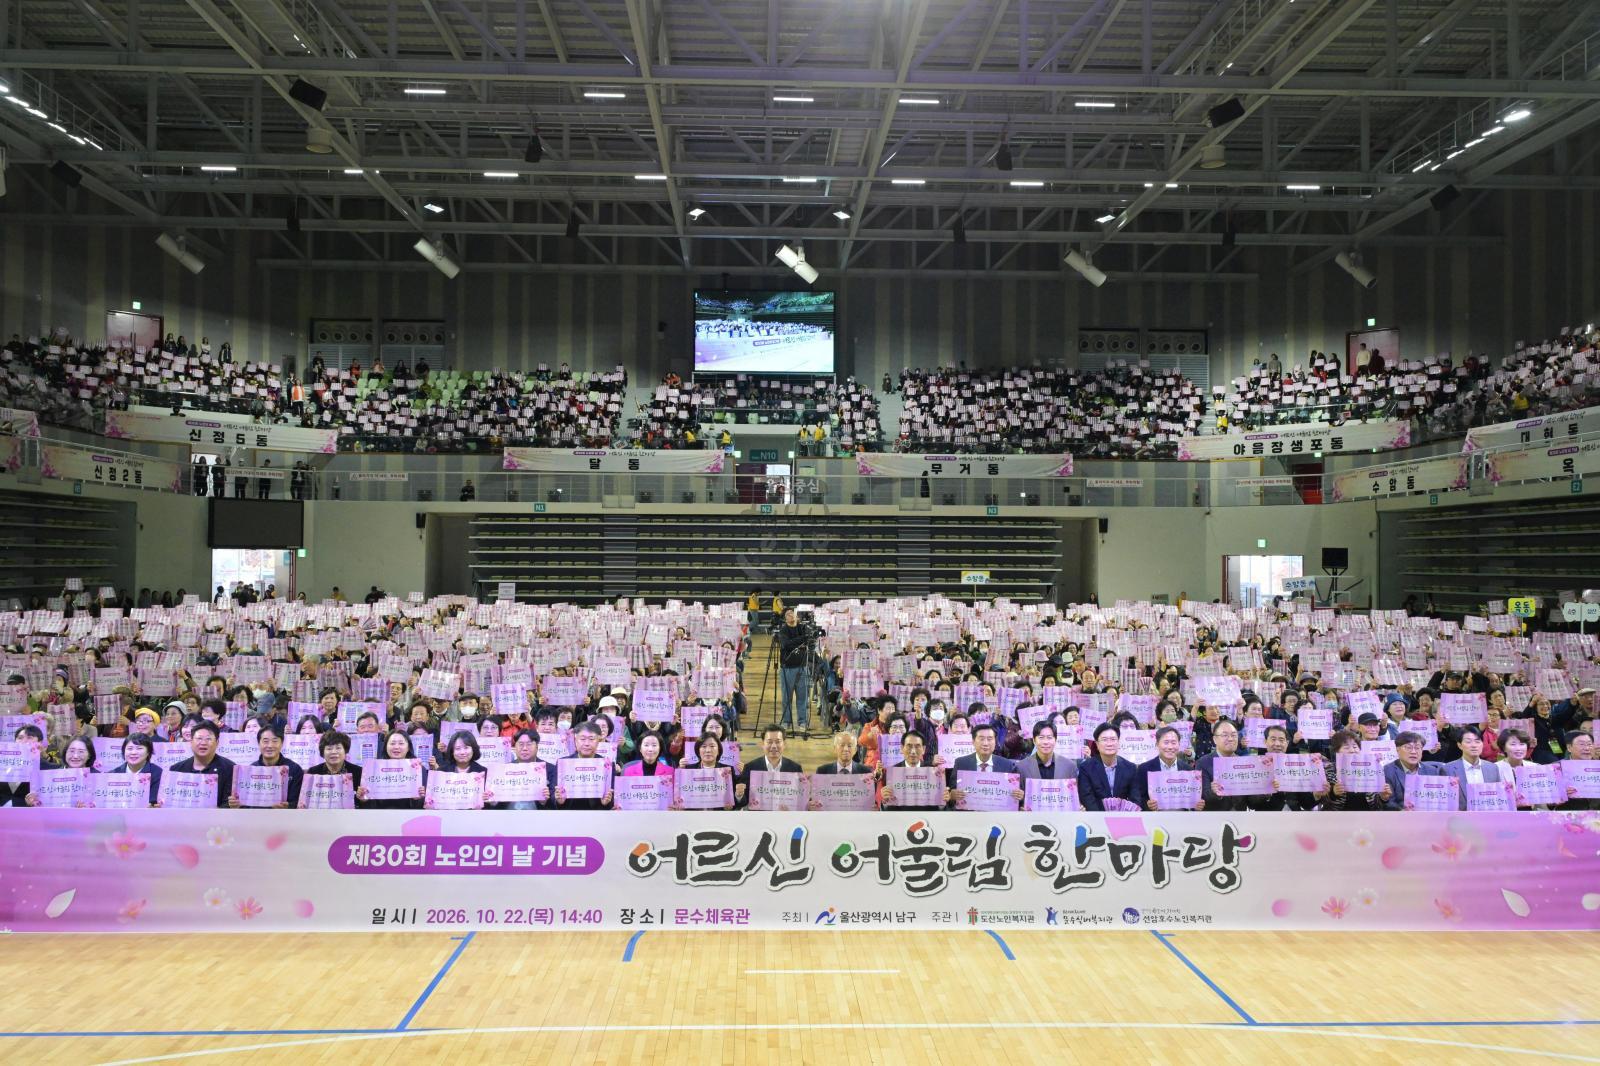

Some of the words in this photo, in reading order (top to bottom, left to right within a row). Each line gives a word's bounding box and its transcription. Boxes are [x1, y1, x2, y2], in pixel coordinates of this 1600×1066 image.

[760, 452, 776, 460] N10
[346, 844, 426, 868] 제30회
[433, 844, 504, 868] 노인의
[511, 844, 533, 868] 날
[542, 844, 588, 868] 기념
[628, 828, 808, 890] 어르신
[831, 821, 1011, 895] 어울림
[1025, 822, 1255, 893] 한마당
[426, 909, 470, 924] 2026.
[476, 909, 498, 924] 10.
[560, 909, 603, 924] 14:40
[674, 908, 750, 924] 문수체육관
[782, 912, 802, 923] 주최
[840, 911, 892, 924] 울산광역시
[895, 912, 916, 924] 남구
[931, 912, 952, 923] 주관
